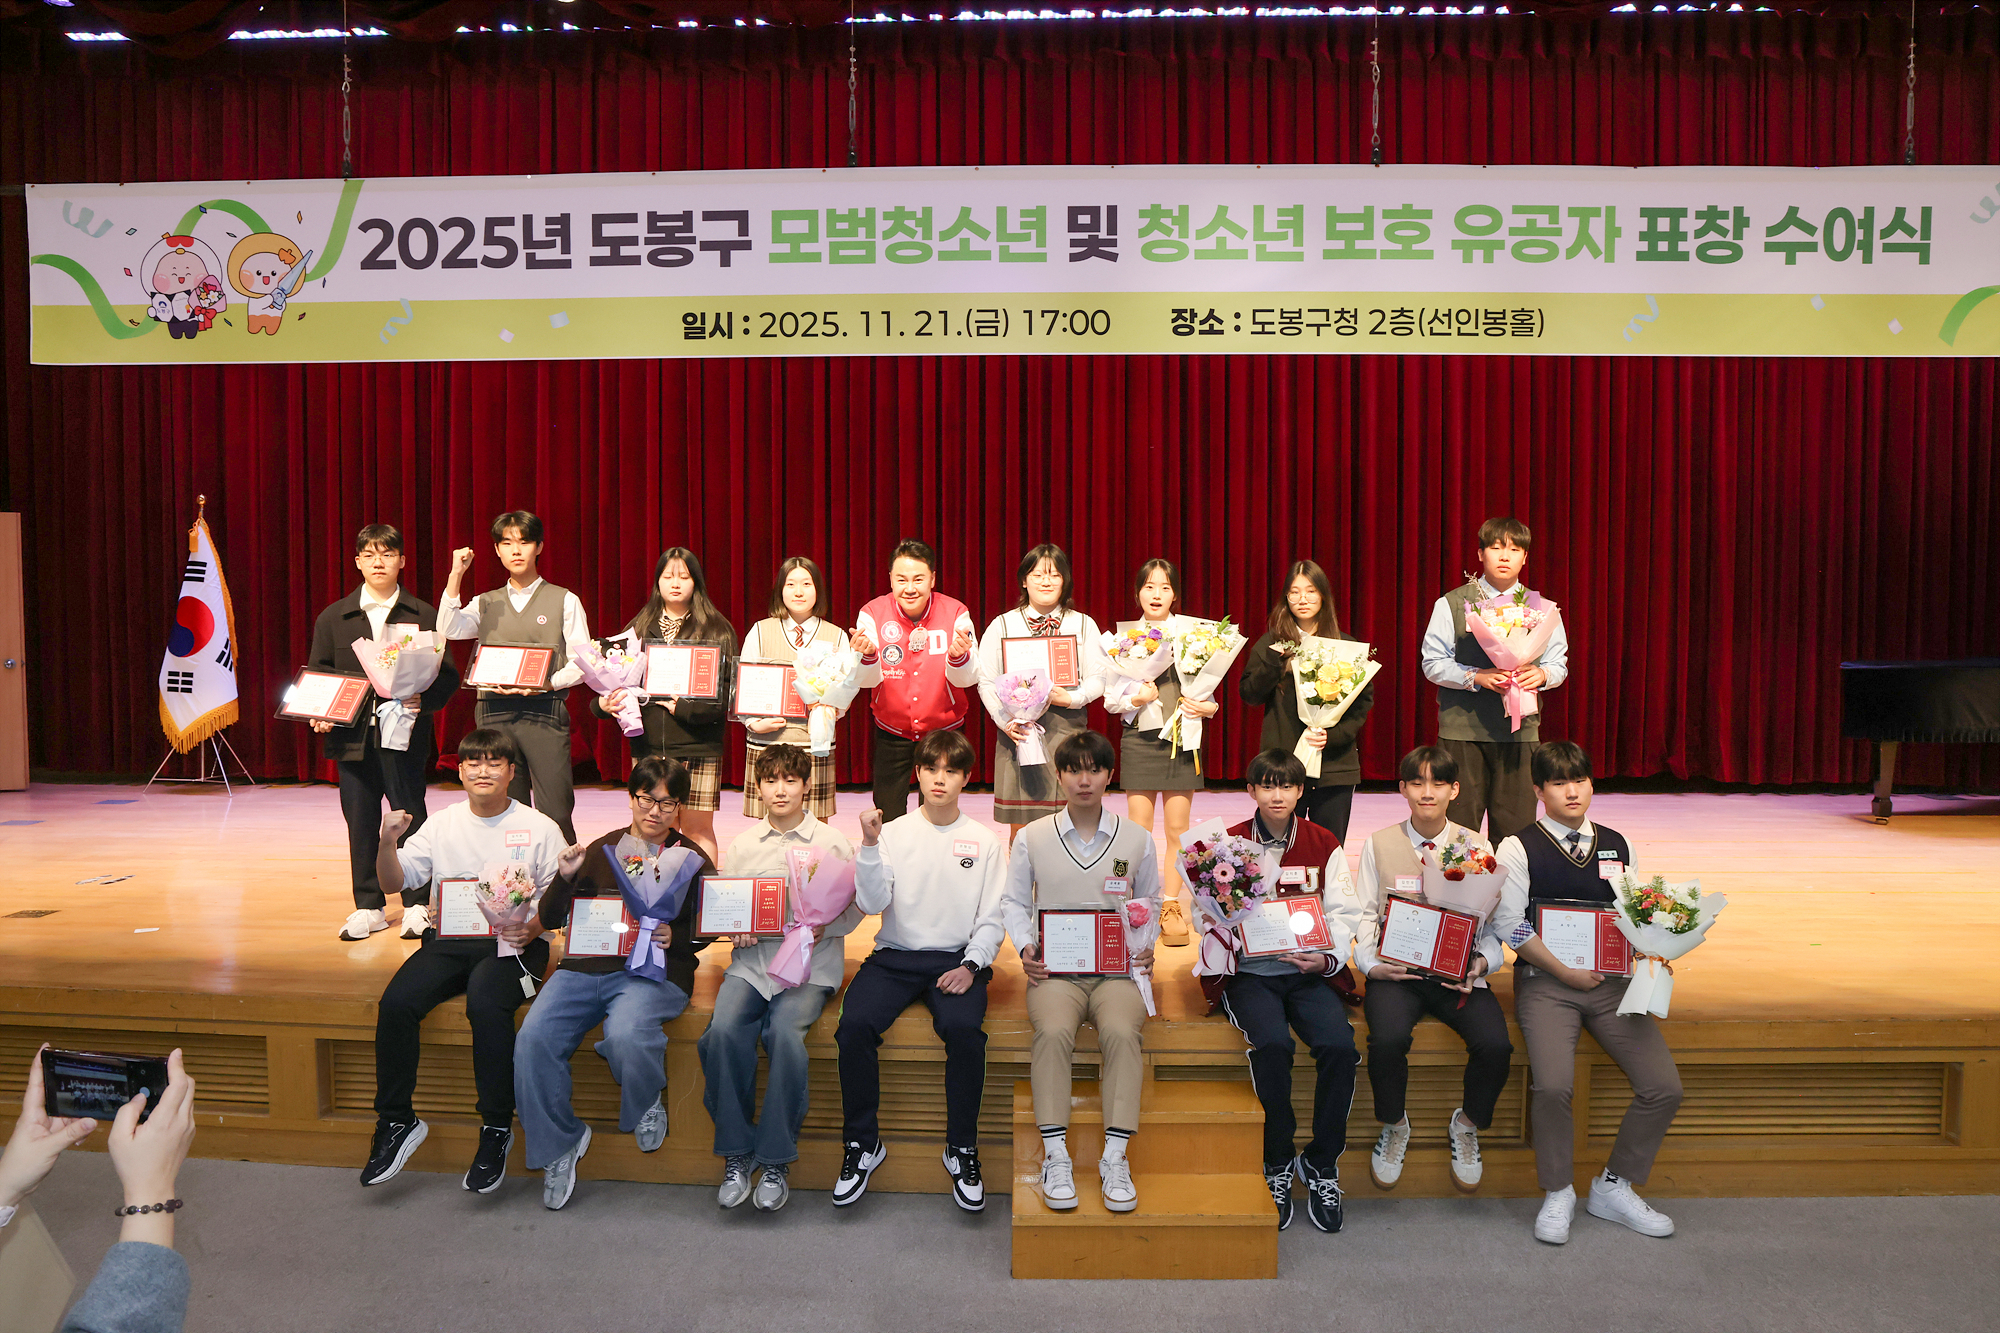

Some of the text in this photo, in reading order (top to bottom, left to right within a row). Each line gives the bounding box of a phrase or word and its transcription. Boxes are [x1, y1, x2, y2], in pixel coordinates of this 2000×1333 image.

[358, 203, 1934, 270] 2025년 도봉구 모범청소년 및 청소년 보호 유공자 표창 수여식
[759, 311, 848, 338] 2025.
[861, 310, 905, 337] 11.
[1022, 309, 1111, 336] 17:00
[1250, 307, 1358, 337] 도봉구청
[1368, 306, 1545, 338] 2층(선인봉홀)
[928, 629, 948, 655] D
[1301, 866, 1320, 893] J
[1337, 871, 1356, 897] 3
